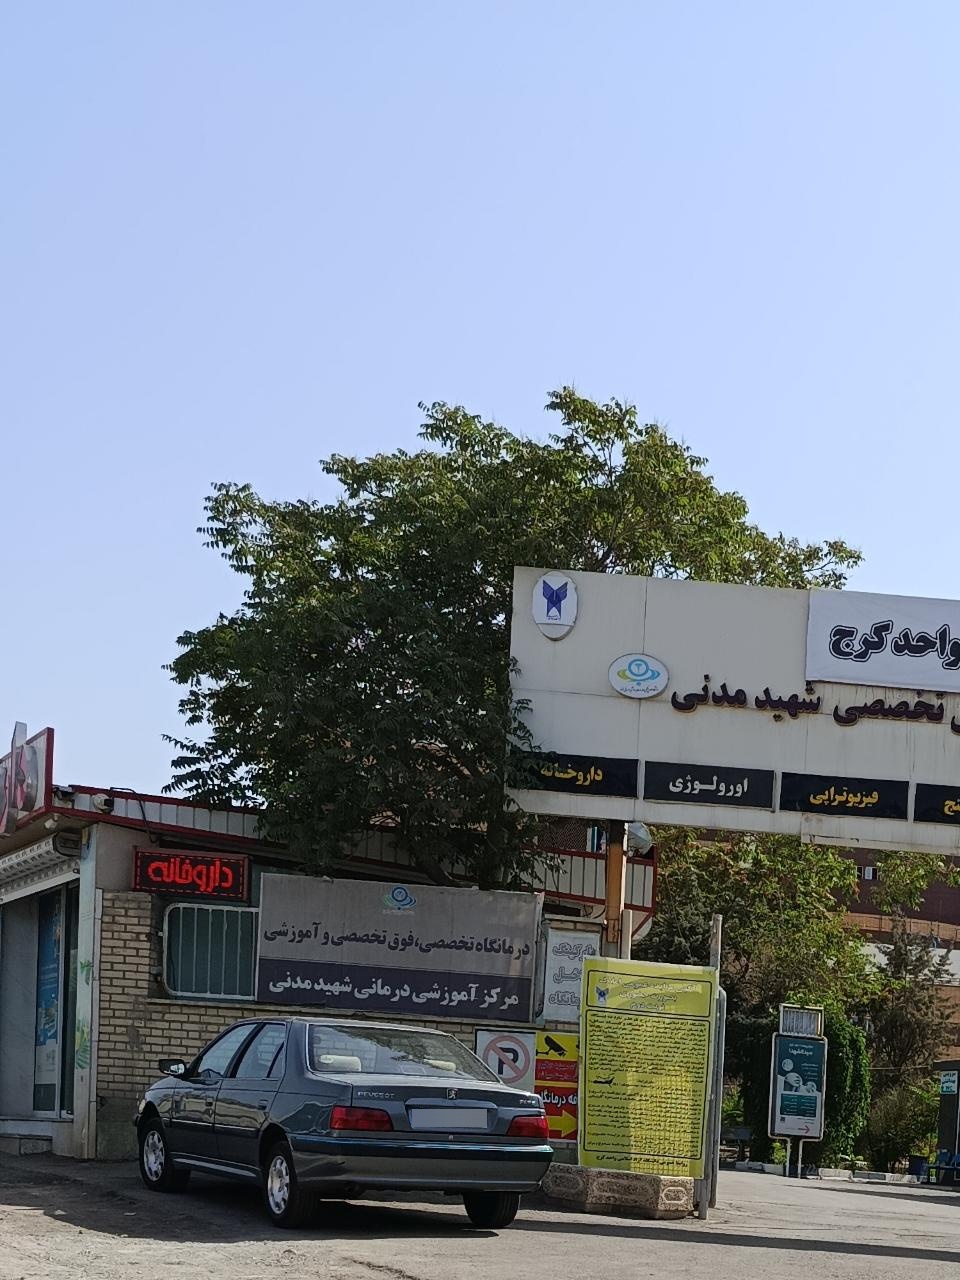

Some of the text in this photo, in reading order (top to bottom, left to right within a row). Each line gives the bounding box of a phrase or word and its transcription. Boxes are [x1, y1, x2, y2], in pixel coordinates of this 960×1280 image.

[829, 620, 893, 661] کرج
[670, 674, 747, 712] مدنی
[755, 681, 821, 722] شهید
[832, 690, 945, 727] تخصصی
[809, 785, 879, 807] فیزیوتراپی
[147, 857, 234, 893] داروخانه
[263, 921, 322, 944] آموزشی
[321, 931, 330, 946] و
[331, 929, 387, 947] تخصصی
[388, 930, 414, 952] فوق
[475, 936, 530, 960] درمانگاه
[268, 971, 519, 1010] مرکز آموزشی درمانی شهید مدنی
[357, 1091, 396, 1099] PEUGEOT
[541, 1088, 567, 1108] درمانگا
